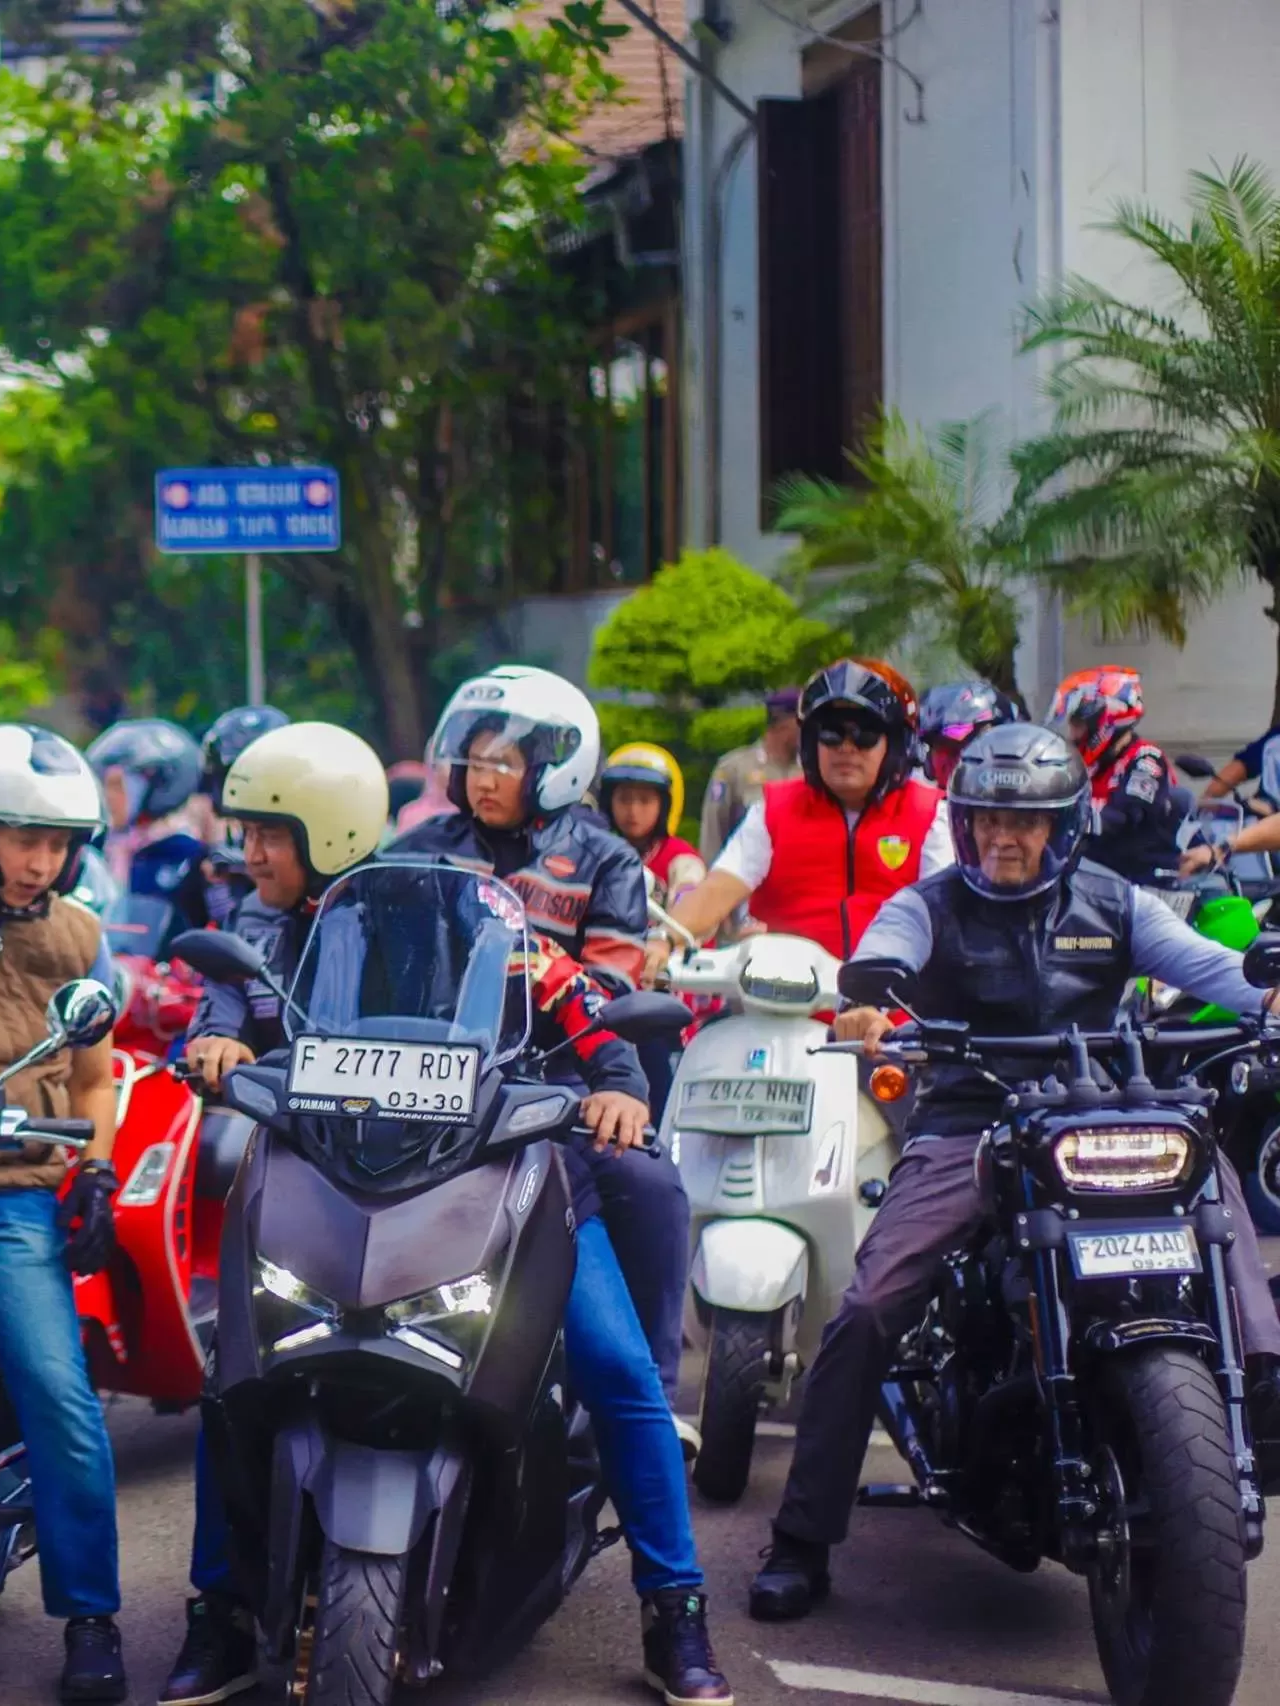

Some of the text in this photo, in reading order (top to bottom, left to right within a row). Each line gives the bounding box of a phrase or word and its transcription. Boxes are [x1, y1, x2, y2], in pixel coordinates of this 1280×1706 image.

[301, 1045, 470, 1081] F 2777 RDY
[299, 1098, 337, 1112] YAMAHA
[377, 1111, 421, 1120] SEMAKIN
[433, 1114, 468, 1122] DEPAN
